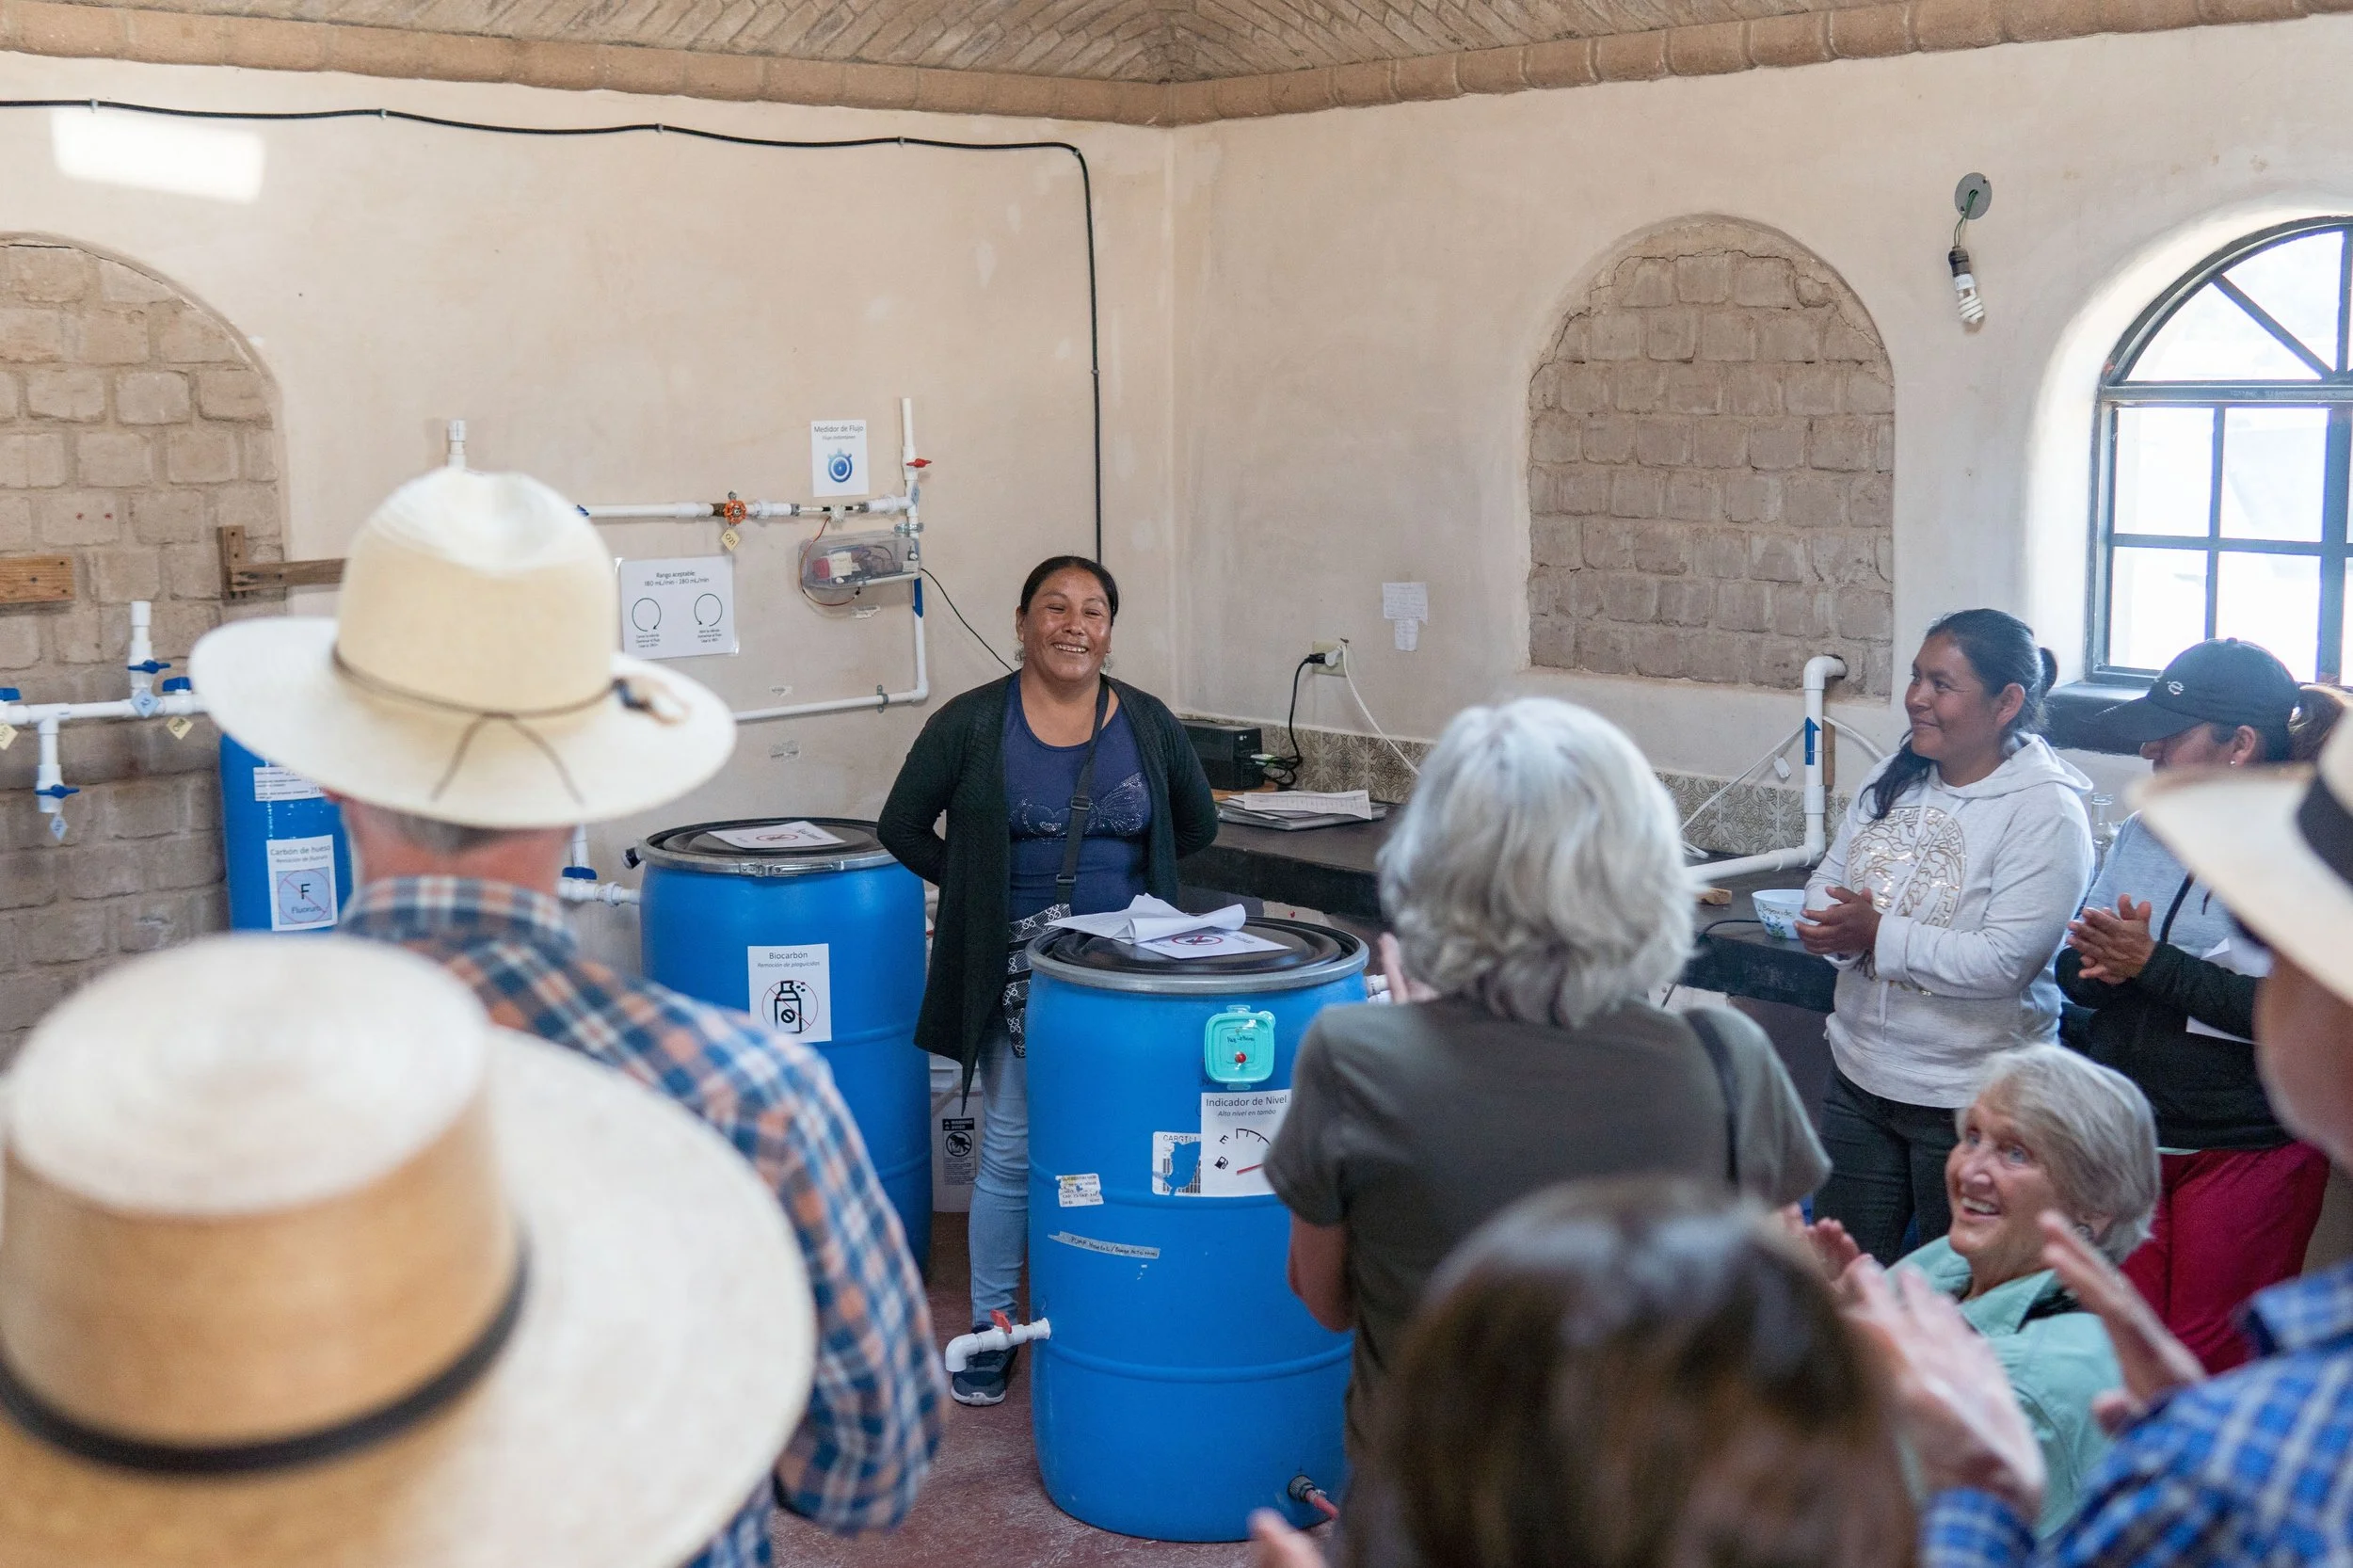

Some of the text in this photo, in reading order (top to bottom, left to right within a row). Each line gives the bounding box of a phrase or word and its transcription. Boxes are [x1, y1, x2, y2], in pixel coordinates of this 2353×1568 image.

[849, 424, 864, 433] Flujo
[270, 847, 298, 856] Carbón
[300, 883, 311, 900] F
[769, 952, 808, 960] Biocarbón
[1206, 1095, 1288, 1107] Indicador de Nivel
[1219, 1134, 1229, 1144] E
